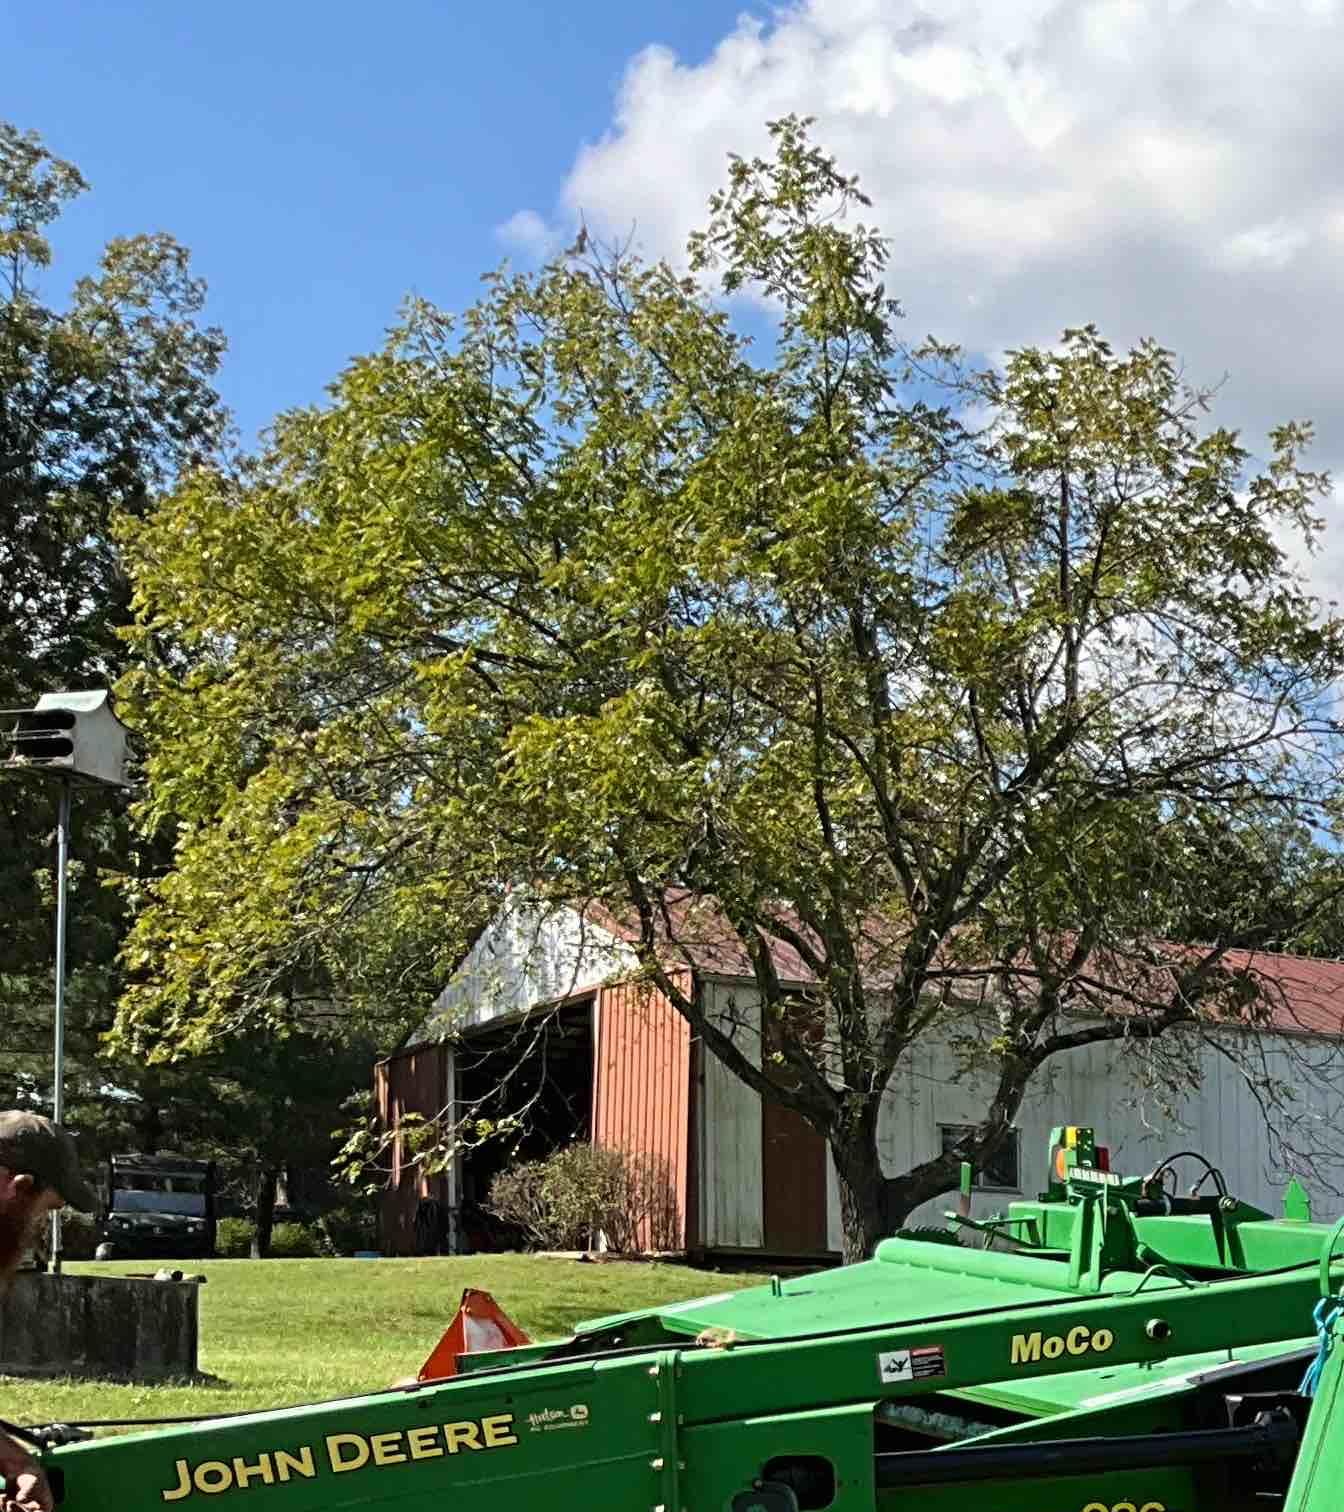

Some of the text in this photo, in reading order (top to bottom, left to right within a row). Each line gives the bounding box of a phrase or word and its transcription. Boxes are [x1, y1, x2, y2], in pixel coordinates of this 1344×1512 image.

[1010, 1326, 1114, 1365] MoCo
[161, 1412, 520, 1502] JOHN DEERE
